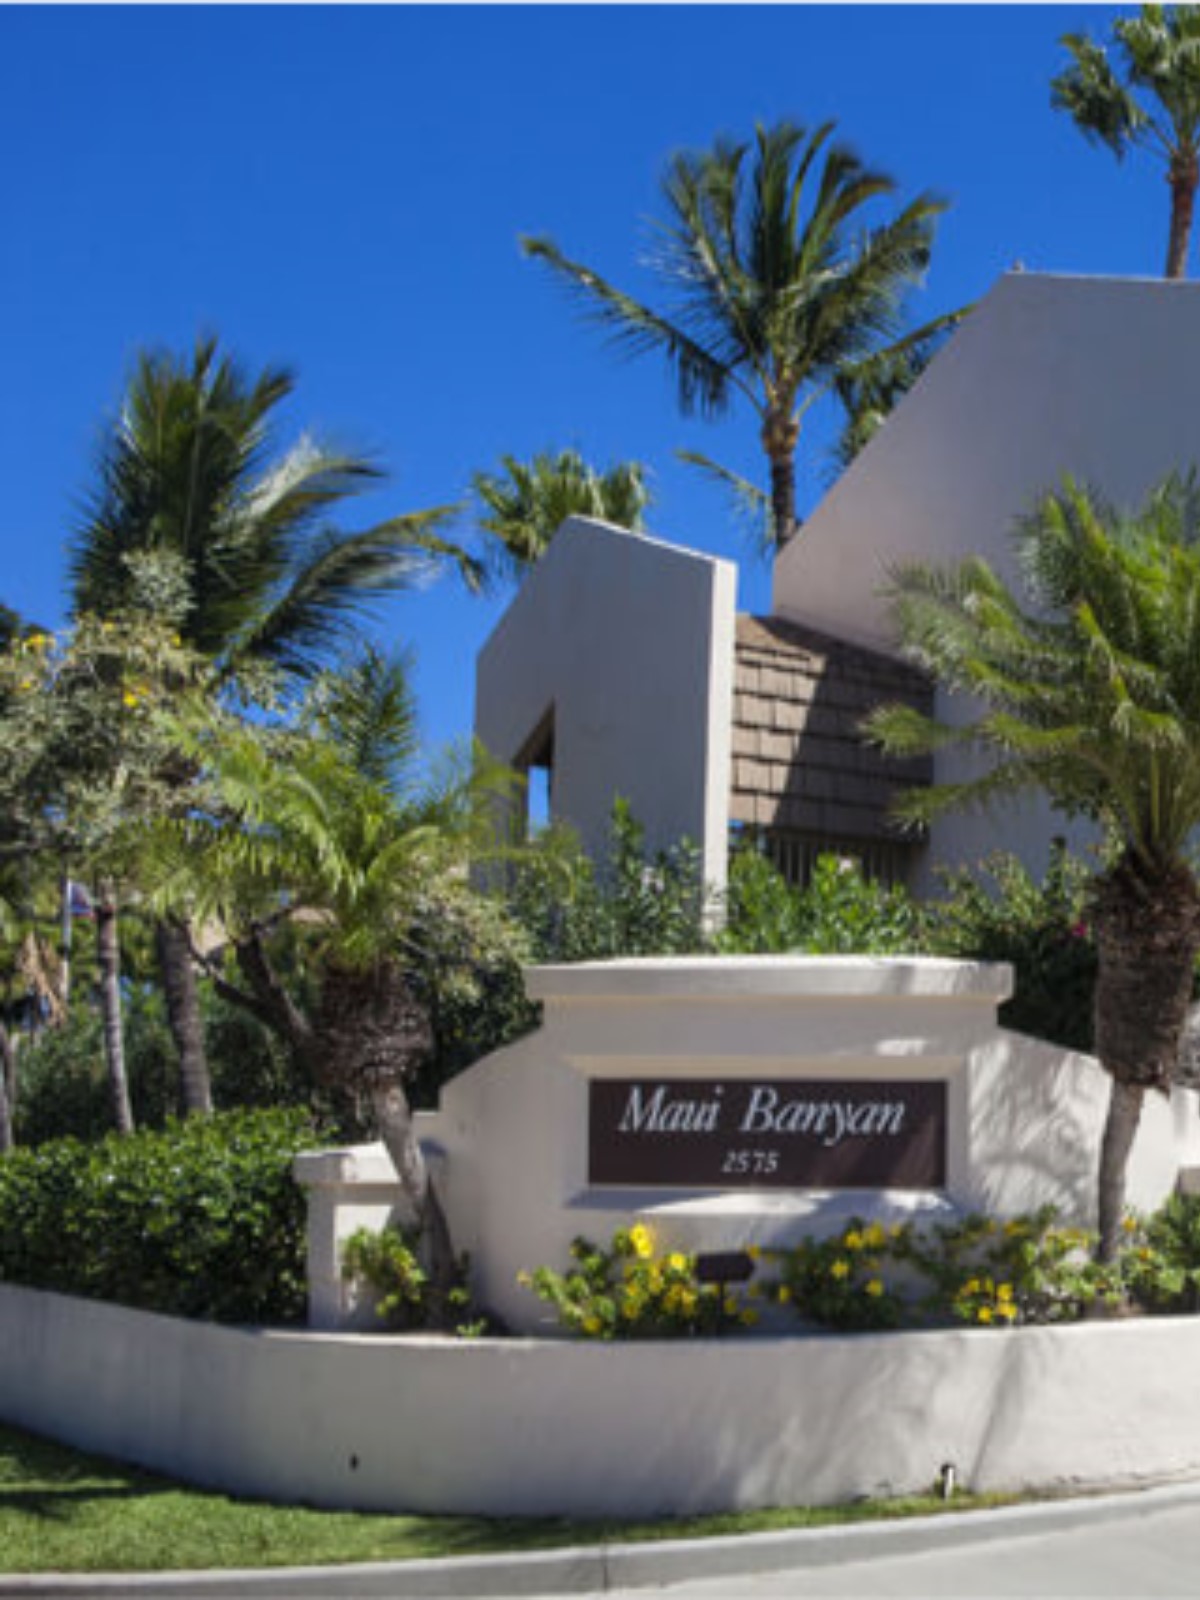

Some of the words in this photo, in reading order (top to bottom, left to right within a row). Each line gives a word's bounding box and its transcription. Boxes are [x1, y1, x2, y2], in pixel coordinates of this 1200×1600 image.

[618, 1085, 724, 1132] Maui
[739, 1085, 905, 1146] Banyan
[722, 1150, 779, 1173] 2575
